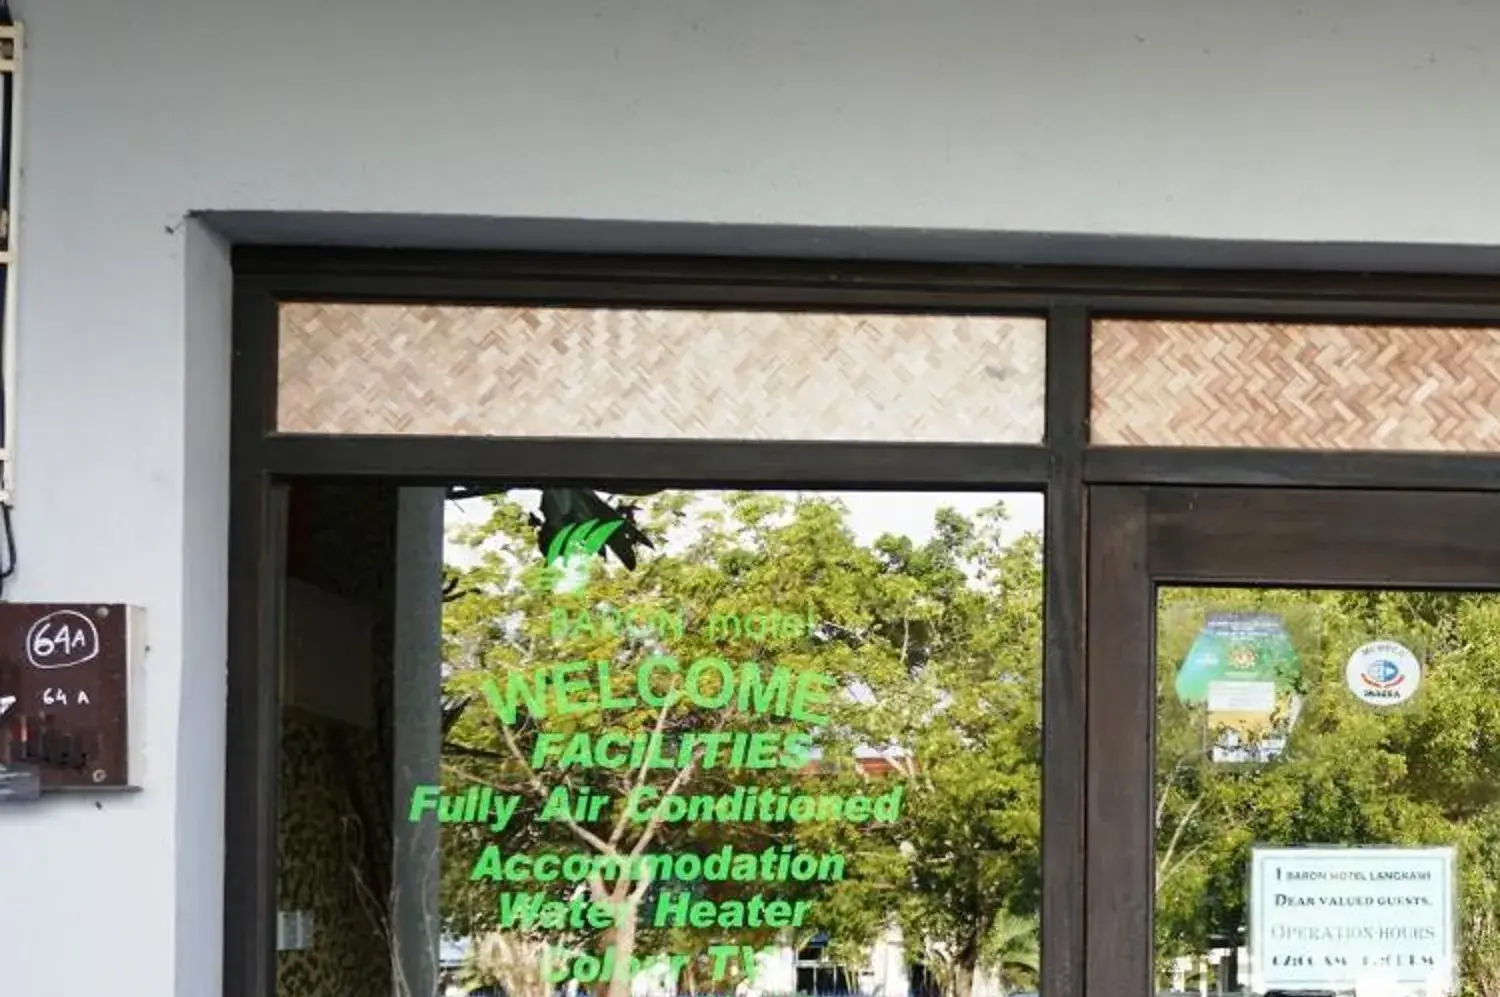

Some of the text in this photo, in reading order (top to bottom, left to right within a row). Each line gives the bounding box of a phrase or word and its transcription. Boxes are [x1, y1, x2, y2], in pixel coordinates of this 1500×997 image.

[33, 623, 87, 656] 64A
[550, 599, 814, 642] BARON motel
[43, 687, 91, 705] 64 A
[483, 655, 838, 726] WELCOME
[531, 731, 817, 770] FACILITIES
[408, 785, 903, 832] Fully Air Conditioned
[470, 844, 846, 883] Accommodation
[653, 891, 812, 930] Heater
